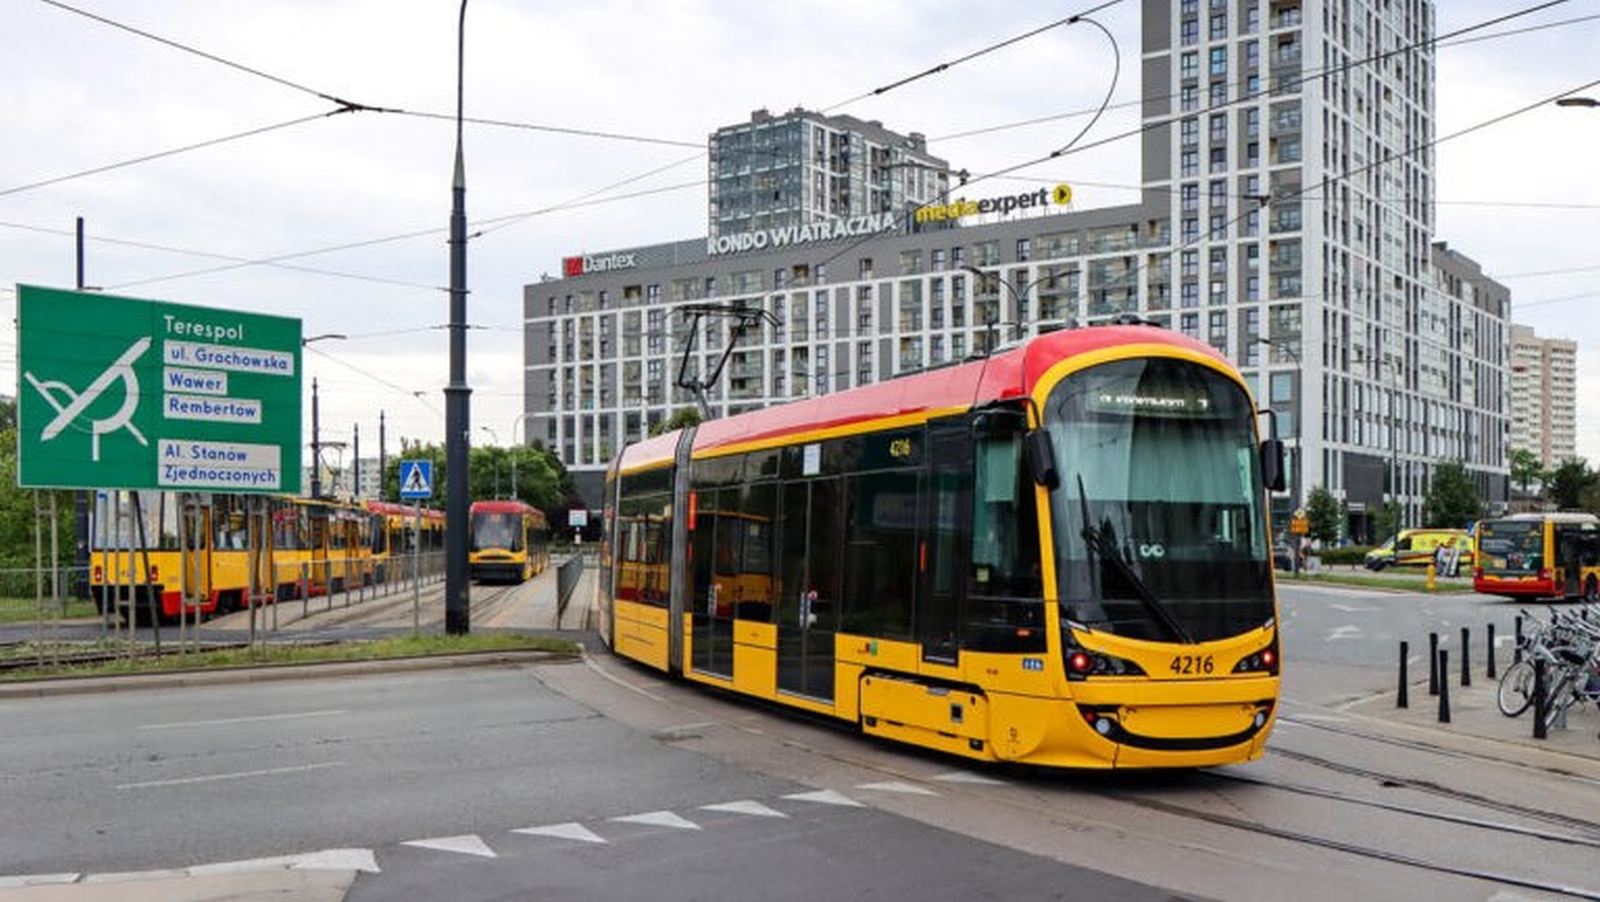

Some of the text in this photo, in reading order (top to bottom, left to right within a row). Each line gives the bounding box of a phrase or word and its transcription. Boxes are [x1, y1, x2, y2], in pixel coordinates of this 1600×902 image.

[708, 211, 897, 254] RONDO WIATRACZNA
[583, 253, 636, 272] Dantex
[164, 314, 243, 343] Terespol
[171, 347, 288, 369] ul. Grochowska
[169, 372, 221, 390] Wawer
[165, 464, 276, 485] Zjednoczonych
[1170, 655, 1214, 674] 4216
